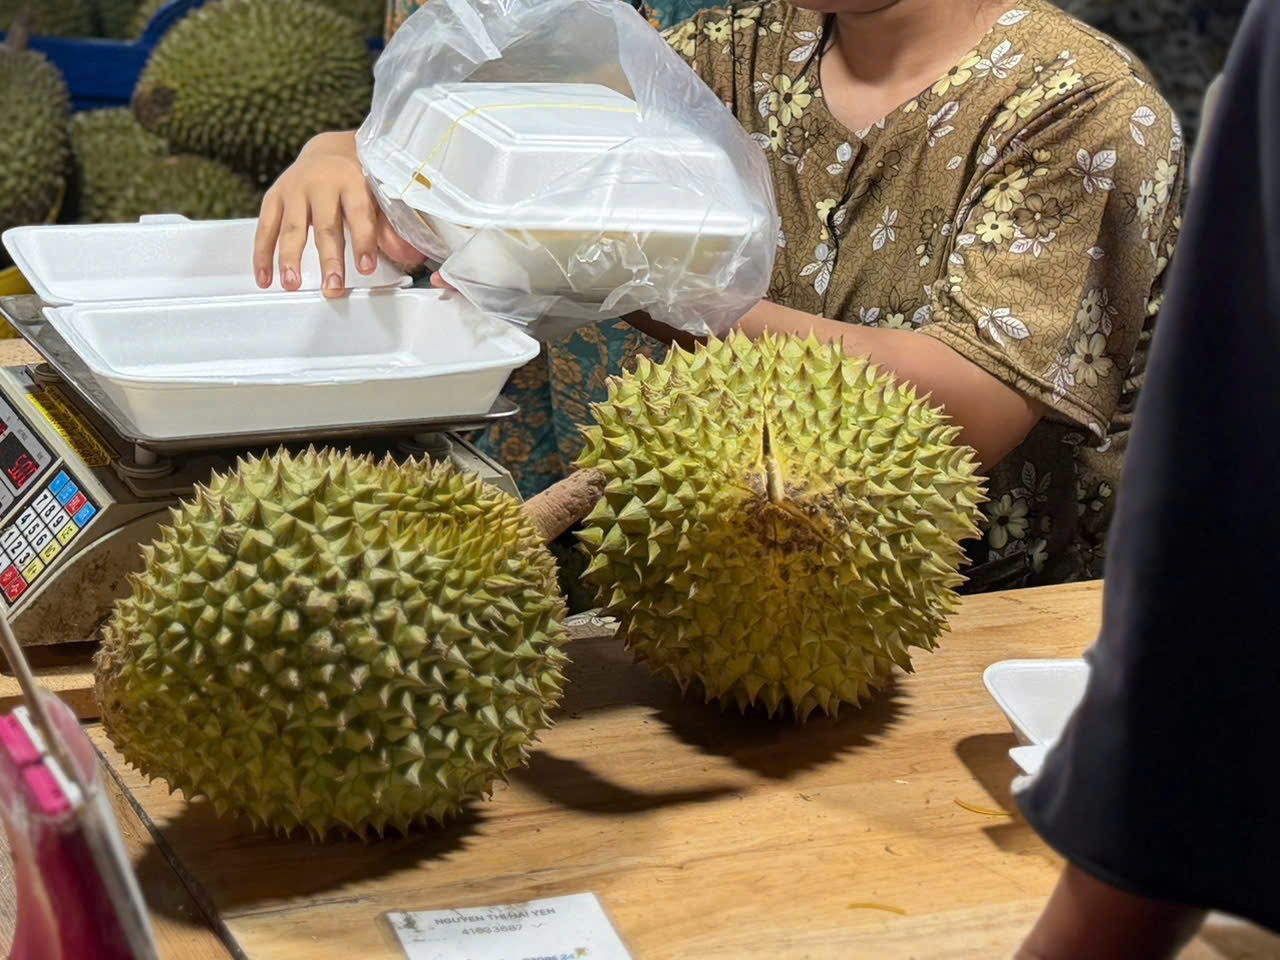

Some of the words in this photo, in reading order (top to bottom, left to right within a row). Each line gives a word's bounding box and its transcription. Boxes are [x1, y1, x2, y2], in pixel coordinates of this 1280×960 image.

[36, 493, 49, 506] 7
[44, 505, 56, 518] 8
[52, 515, 64, 528] 9
[20, 513, 32, 525] 4
[28, 523, 40, 535] 5
[35, 534, 48, 547] 6
[3, 531, 16, 543] 1
[11, 541, 23, 554] 2
[18, 552, 31, 565] 3
